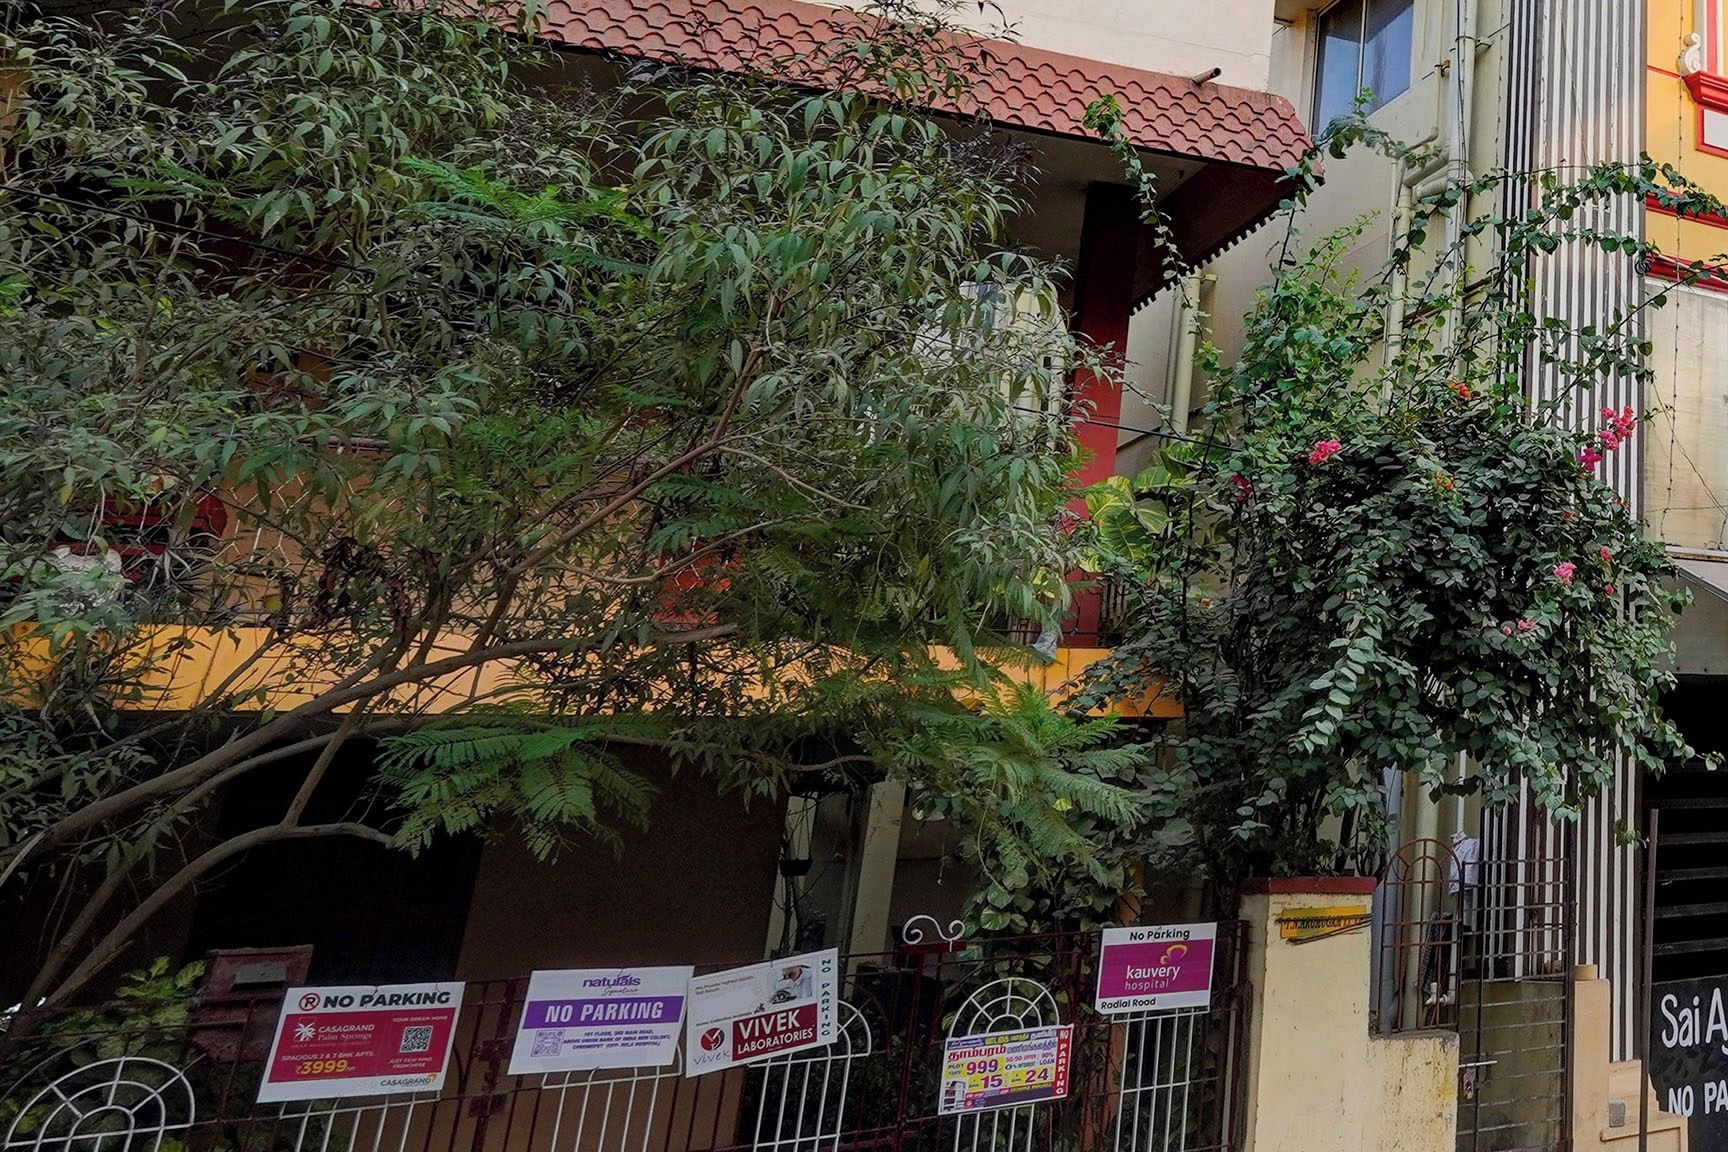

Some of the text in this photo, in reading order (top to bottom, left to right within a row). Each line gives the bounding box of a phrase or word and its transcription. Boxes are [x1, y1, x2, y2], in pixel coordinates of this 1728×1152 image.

[1129, 929, 1190, 941] No Parking
[821, 959, 832, 973] NO
[1126, 965, 1181, 981] kauvery
[582, 974, 641, 988] naturals
[1125, 978, 1169, 991] hospital
[323, 991, 451, 1008] NO PARKING
[1101, 998, 1156, 1009] Radial Road
[545, 1001, 664, 1023] NO PARKING
[821, 982, 831, 1037] PARKING
[738, 1009, 801, 1040] VIVEK
[1661, 993, 1700, 1048] Sai
[318, 1024, 375, 1034] CASAGRAND
[317, 1033, 372, 1043] Palm Springs
[737, 1028, 813, 1054] LABORATORIES
[966, 1059, 998, 1076] 999
[1039, 1058, 1055, 1066] LOAN
[1056, 1044, 1067, 1094] PARKING
[381, 1078, 431, 1086] CASAGRAND
[981, 1074, 1003, 1089] 15
[1024, 1068, 1048, 1084] 24
[1668, 1085, 1694, 1118] NO
